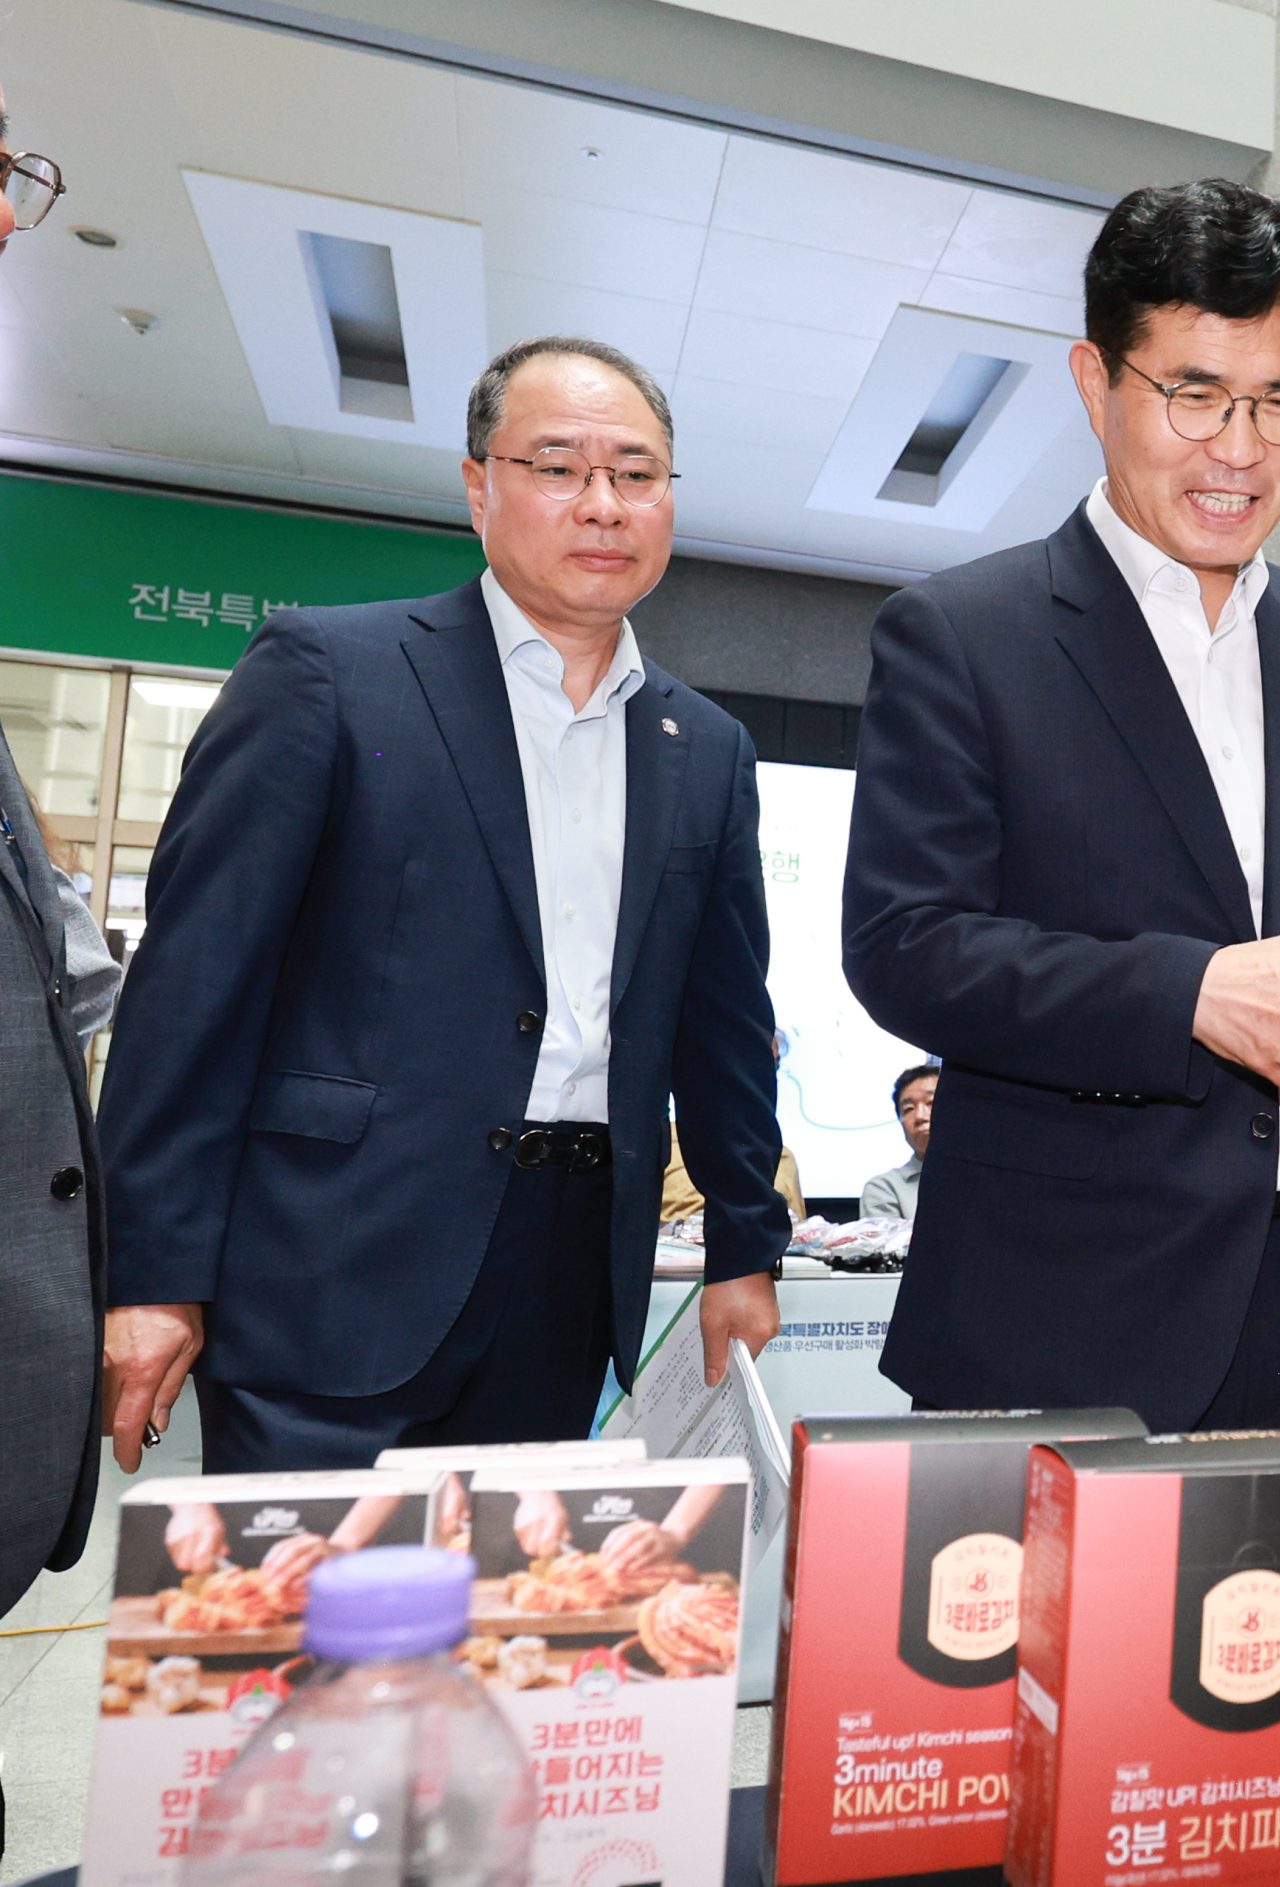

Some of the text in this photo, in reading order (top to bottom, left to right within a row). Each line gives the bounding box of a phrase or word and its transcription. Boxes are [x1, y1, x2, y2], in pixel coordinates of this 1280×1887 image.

[760, 850, 800, 883] 행
[779, 1322, 865, 1337] 북특별자치도
[531, 1716, 643, 1751] 3분만에
[918, 1729, 963, 1748] Kimchi
[965, 1727, 1013, 1745] season
[528, 1751, 664, 1786] 들어지는
[834, 1753, 943, 1786] 3minute
[533, 1783, 661, 1820] 치시즈닝
[832, 1778, 949, 1819] KIMCHI
[1105, 1819, 1168, 1867] 3분
